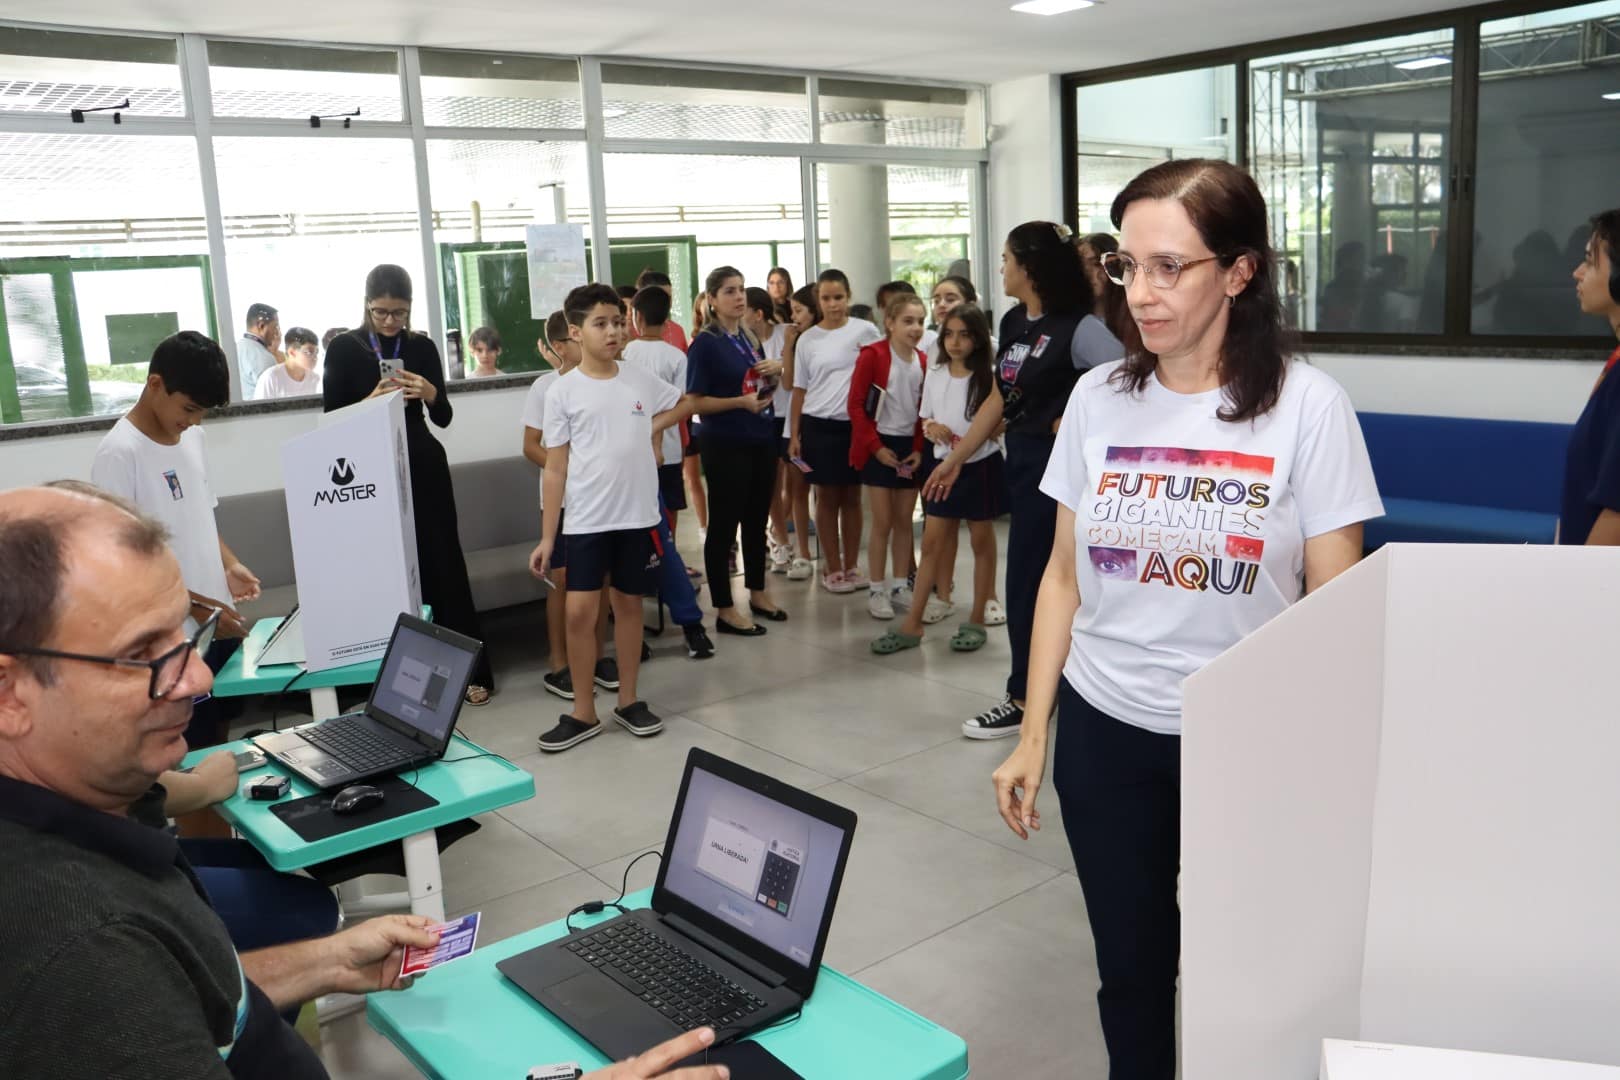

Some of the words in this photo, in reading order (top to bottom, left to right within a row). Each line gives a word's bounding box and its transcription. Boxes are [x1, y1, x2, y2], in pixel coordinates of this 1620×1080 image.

[313, 484, 376, 507] MASTER
[1097, 472, 1270, 508] FUTUROS
[1088, 496, 1267, 539] GIGANTES
[1139, 551, 1259, 595] AQUI
